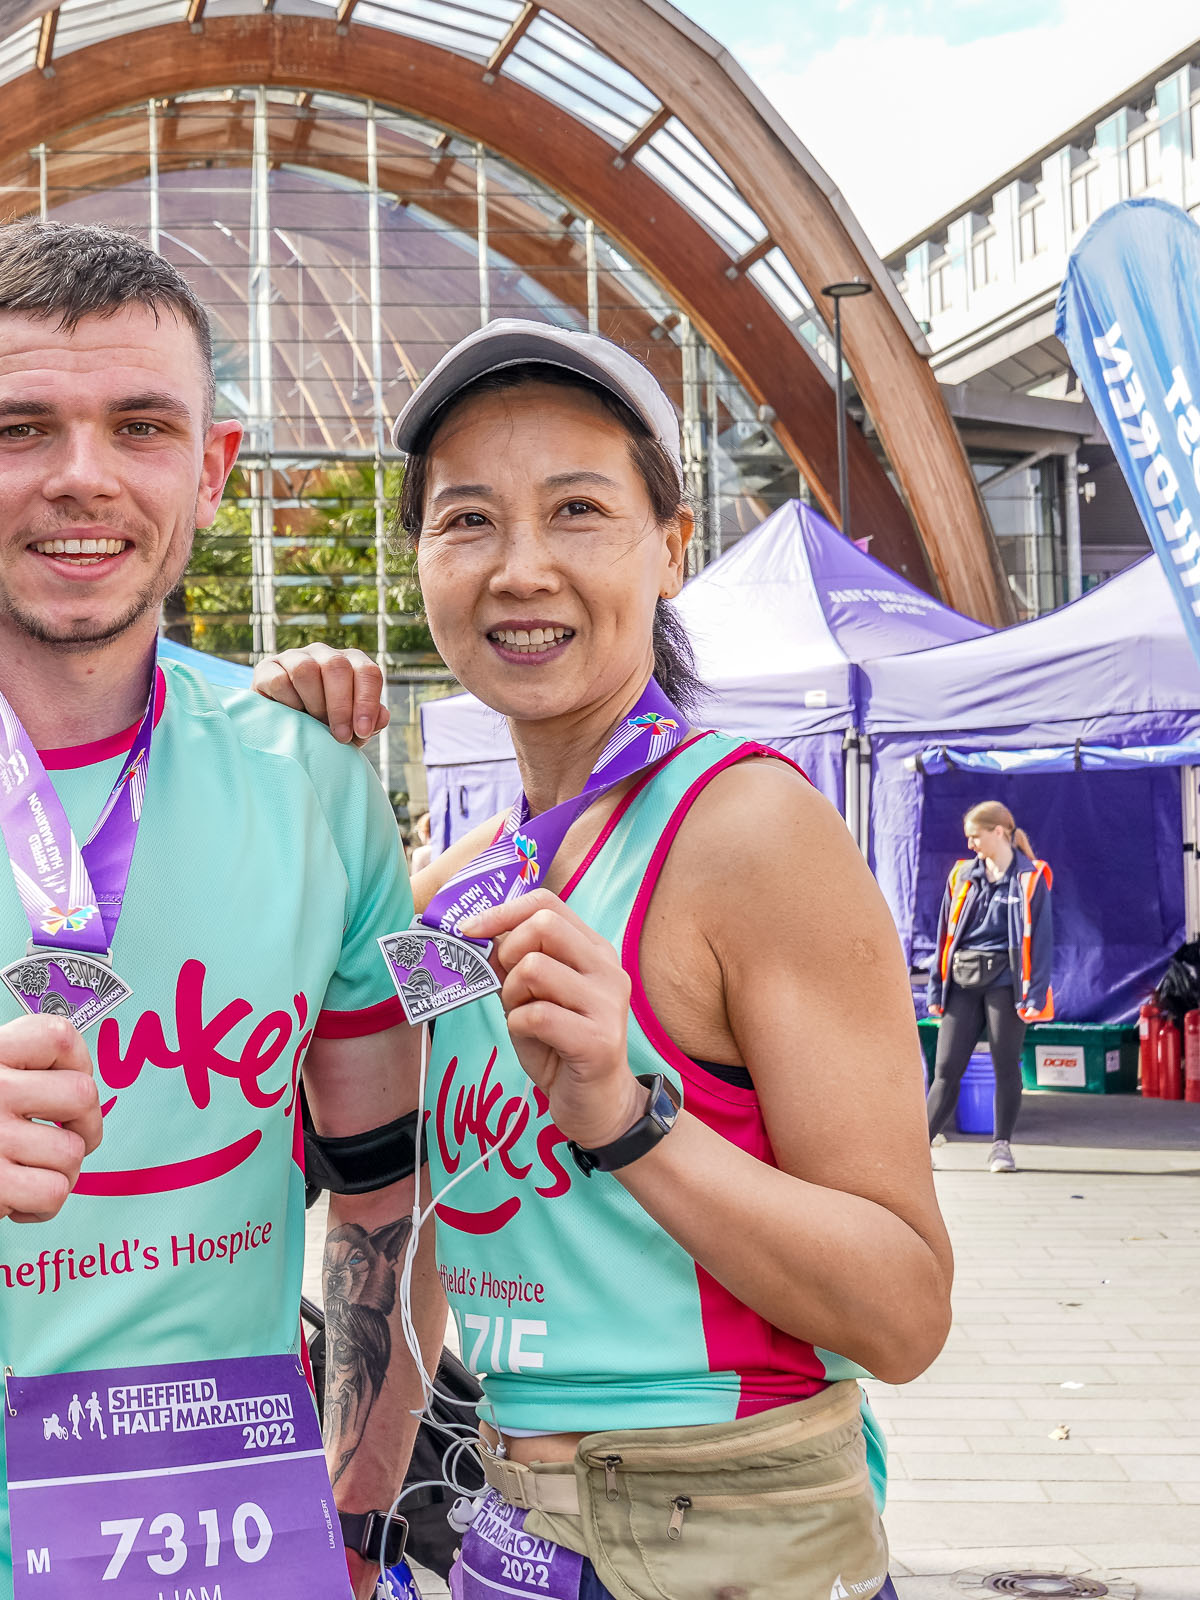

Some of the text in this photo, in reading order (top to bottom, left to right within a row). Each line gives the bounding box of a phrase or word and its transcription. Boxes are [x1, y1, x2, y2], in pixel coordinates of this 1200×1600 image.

[27, 791, 65, 870] HALF MARATHON
[27, 836, 51, 875] SHEFFIELD
[458, 883, 484, 909] HALF
[87, 987, 123, 1019] MARATHON
[449, 978, 492, 1002] MARATHON
[171, 1219, 273, 1267] Hospice
[480, 1271, 545, 1308] Hospice
[111, 1381, 214, 1410] SHEFFIELD
[112, 1397, 291, 1436] HALF MARATHON
[242, 1421, 296, 1450] 2022
[100, 1501, 274, 1581] 7310
[320, 1499, 336, 1549] LIAM GILBERT
[26, 1547, 51, 1575] M
[500, 1555, 550, 1589] 2022
